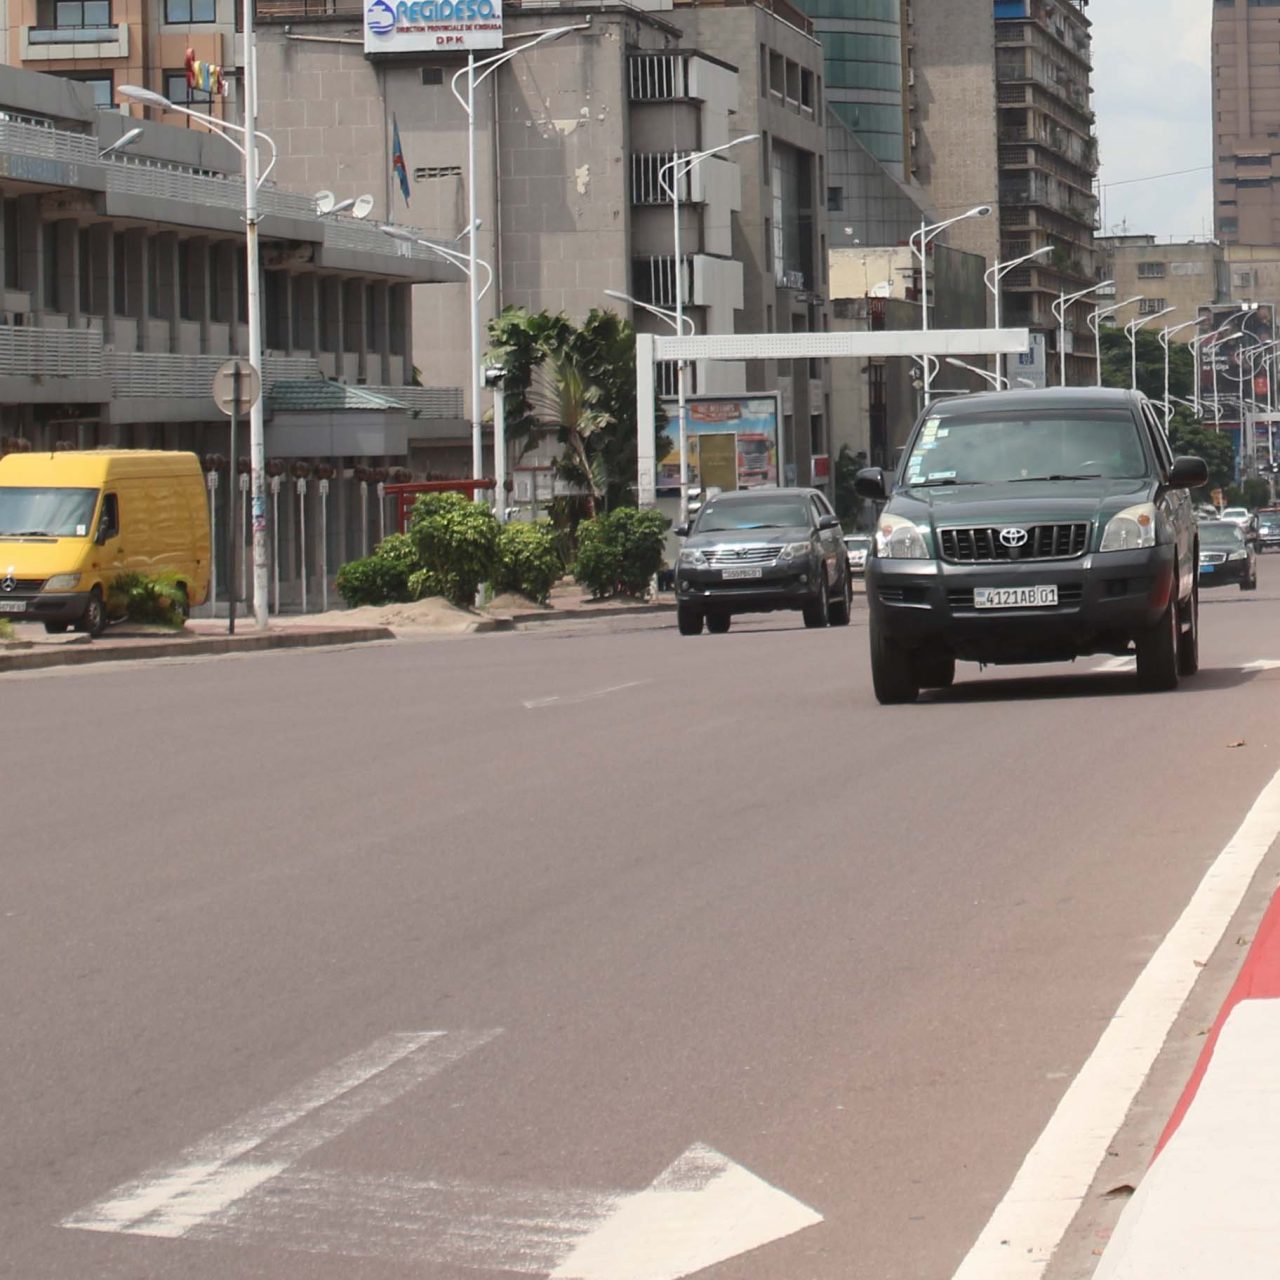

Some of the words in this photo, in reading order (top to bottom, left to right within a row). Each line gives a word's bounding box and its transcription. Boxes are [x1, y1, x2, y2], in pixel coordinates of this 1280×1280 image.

[396, 25, 426, 33] DIRECTION
[427, 24, 465, 32] PROVINCIALE
[474, 23, 502, 31] KINSHASA
[986, 589, 1036, 606] 4121AB
[1040, 588, 1056, 603] 01
